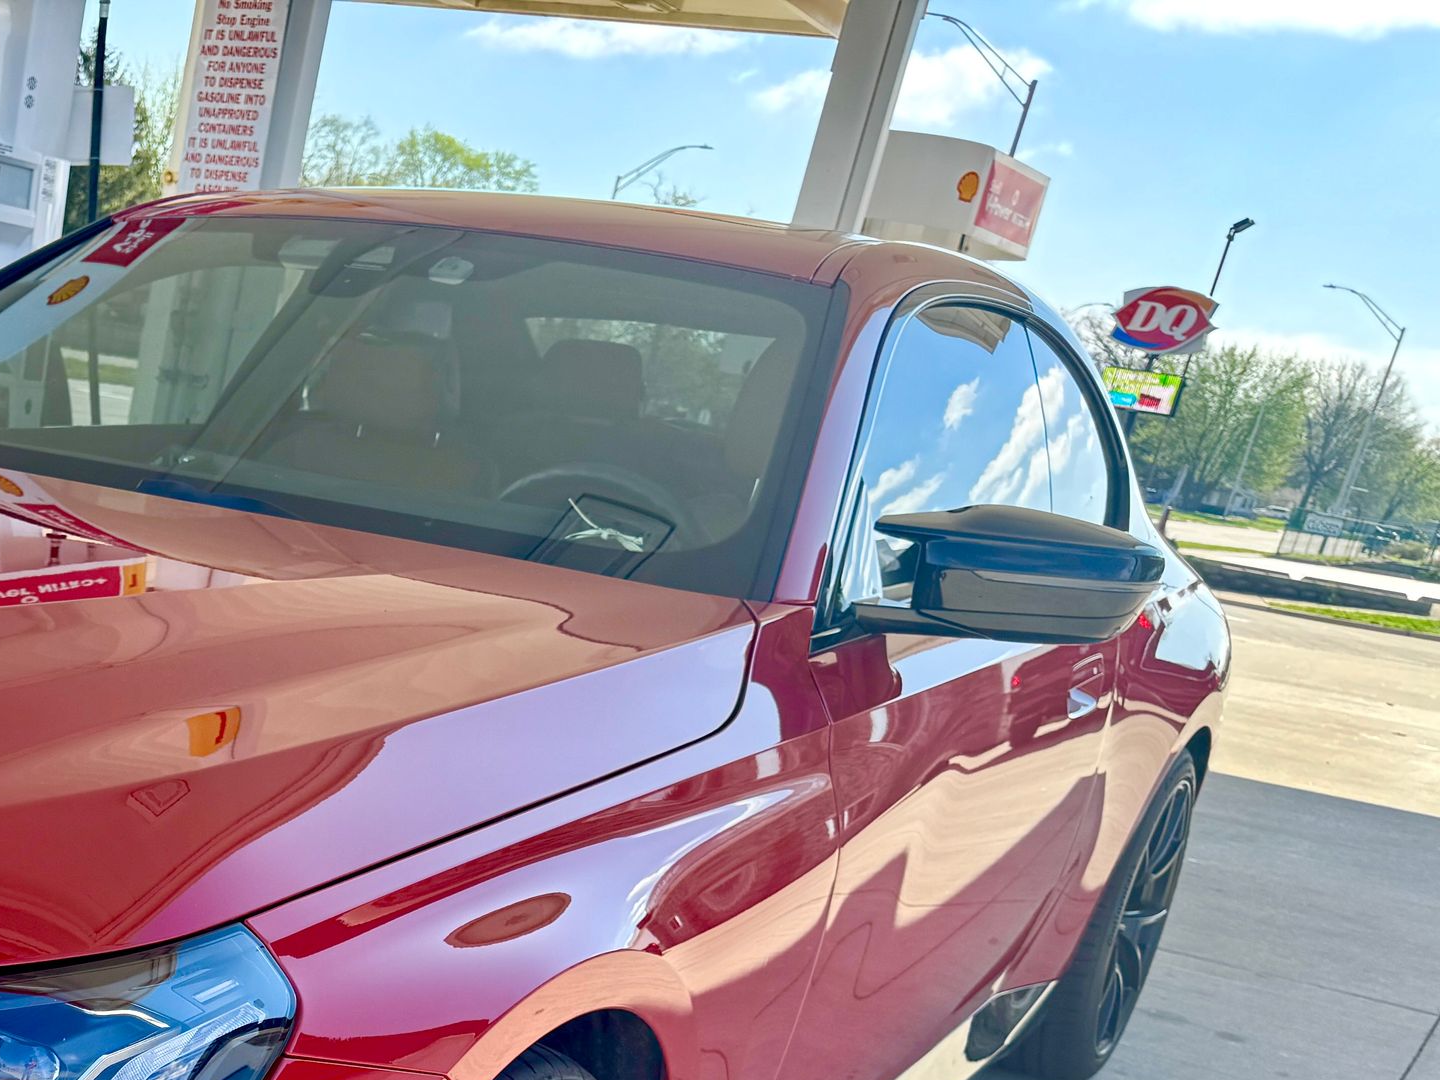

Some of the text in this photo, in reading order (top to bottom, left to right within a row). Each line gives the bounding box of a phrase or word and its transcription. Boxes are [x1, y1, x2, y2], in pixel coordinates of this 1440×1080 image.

[233, 0, 273, 12] Smoking
[216, 13, 271, 28] Stop Engine
[203, 29, 277, 42] IT IS UNLAWFUL
[200, 44, 278, 59] AND DANGEROUS
[206, 61, 266, 74] FOR ANYONE
[204, 76, 264, 90] TO DISPENSE
[196, 91, 266, 106] GASOLINE INTO
[198, 107, 259, 121] UNAPPROVED
[198, 122, 255, 136] CONTAINERS
[188, 137, 259, 153] IT IS UNLAWFUL
[184, 152, 260, 168] AND DANGEROUS
[190, 168, 248, 183] TO DISPENSE
[1126, 300, 1198, 342] DQ
